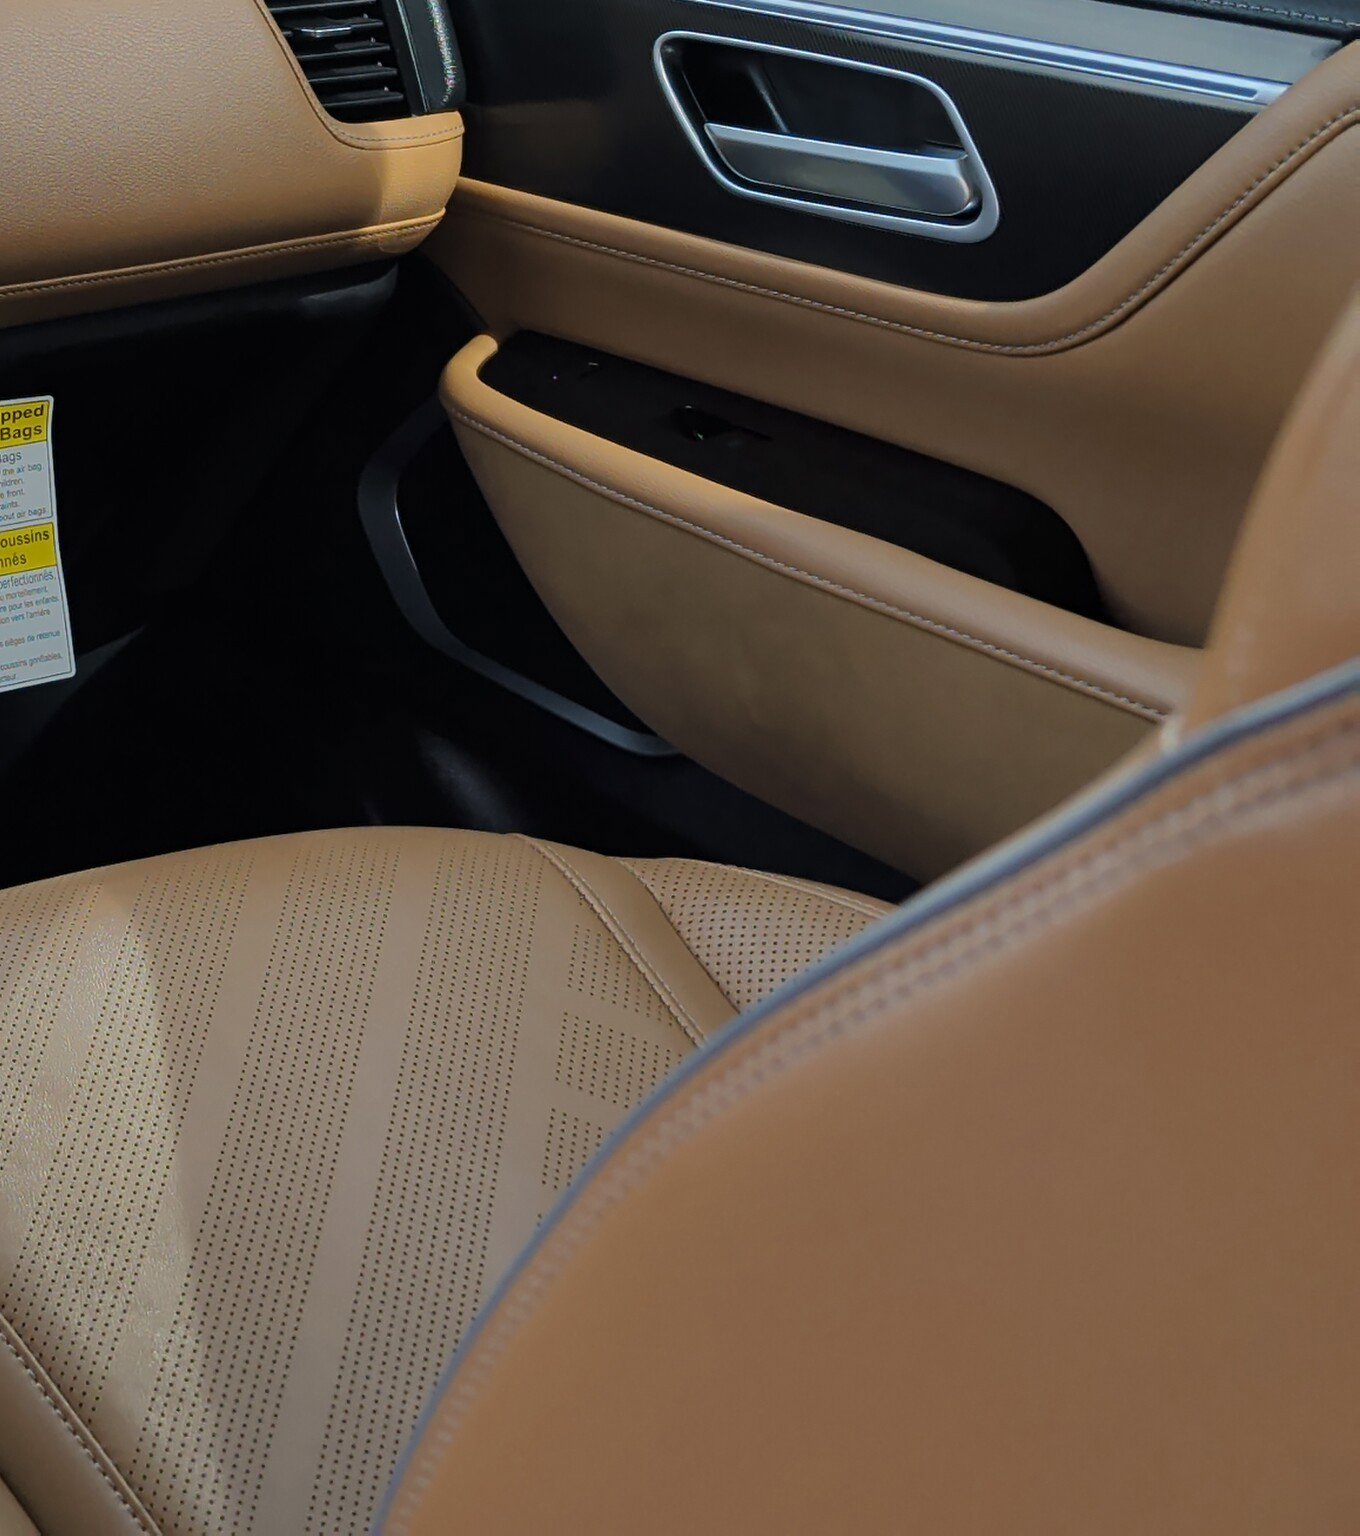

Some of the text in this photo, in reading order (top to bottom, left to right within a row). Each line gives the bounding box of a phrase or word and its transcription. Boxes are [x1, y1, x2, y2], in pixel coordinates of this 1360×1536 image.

[0, 421, 42, 444] Bags
[2, 467, 14, 475] the
[16, 465, 24, 473] air
